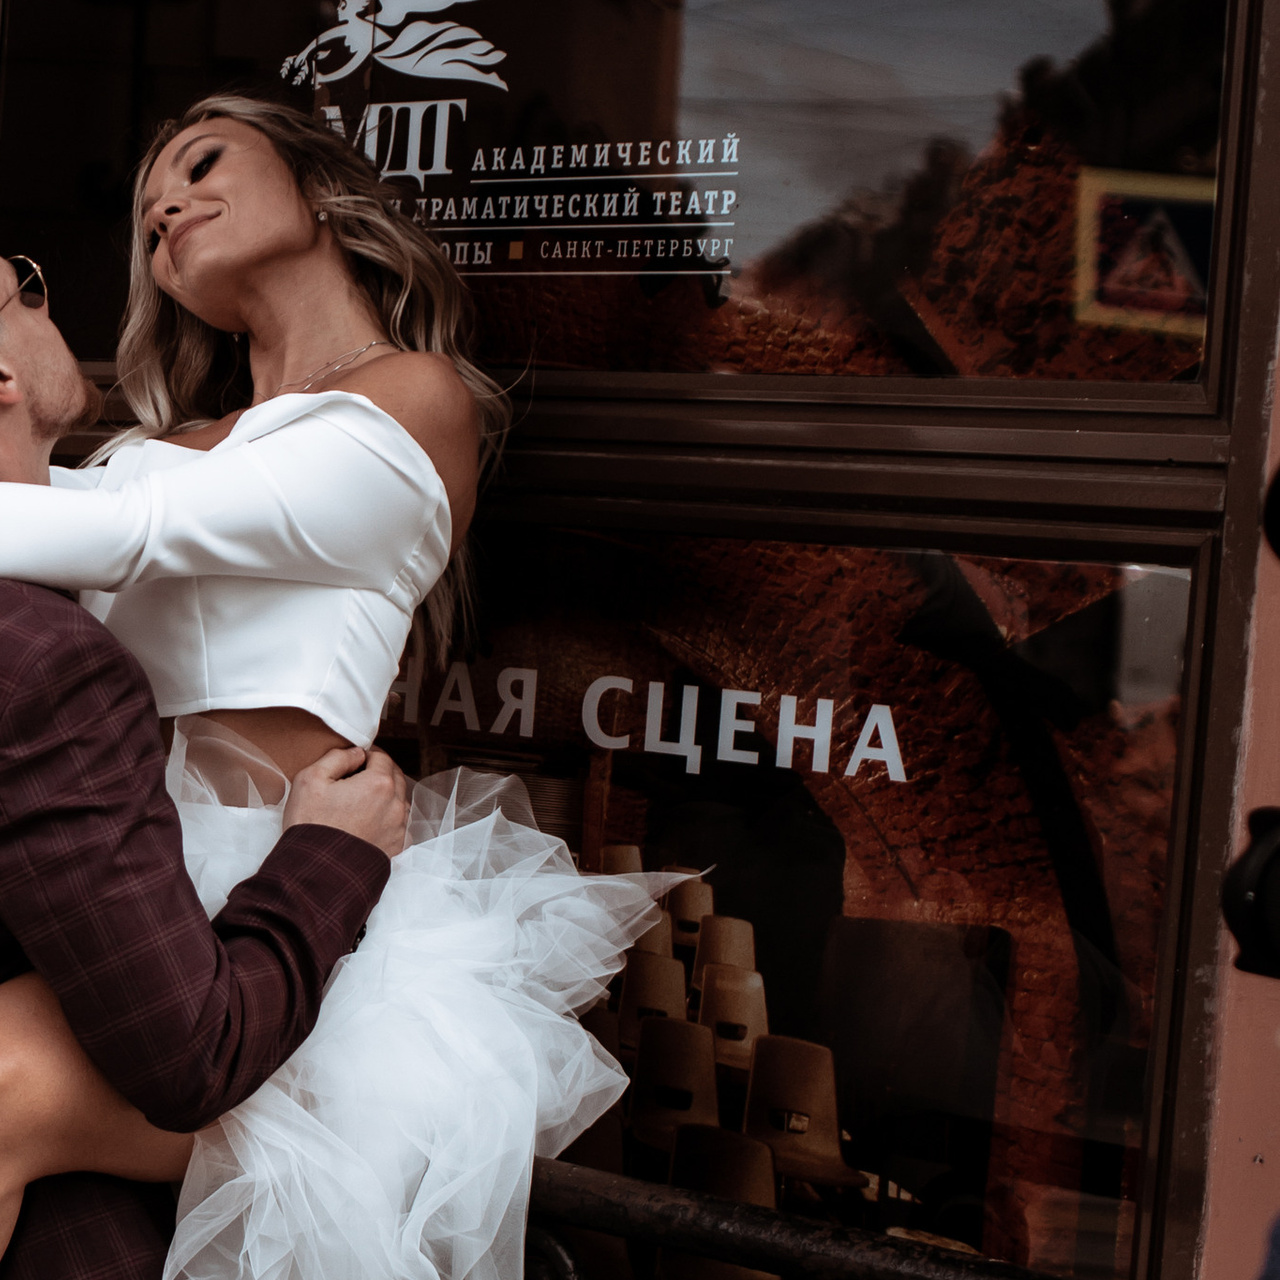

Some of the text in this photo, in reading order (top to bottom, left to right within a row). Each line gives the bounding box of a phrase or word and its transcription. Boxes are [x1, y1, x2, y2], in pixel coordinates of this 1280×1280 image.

[471, 132, 741, 175] АКАДЕМИЧЕСКИЙ
[412, 187, 641, 225] ДРАМАТИЧЕСКИЙ
[652, 189, 738, 217] ТЕАТР
[539, 238, 735, 260] САНКТ-ПЕТЕРБУРГ
[581, 675, 908, 783] СЦЕНА
